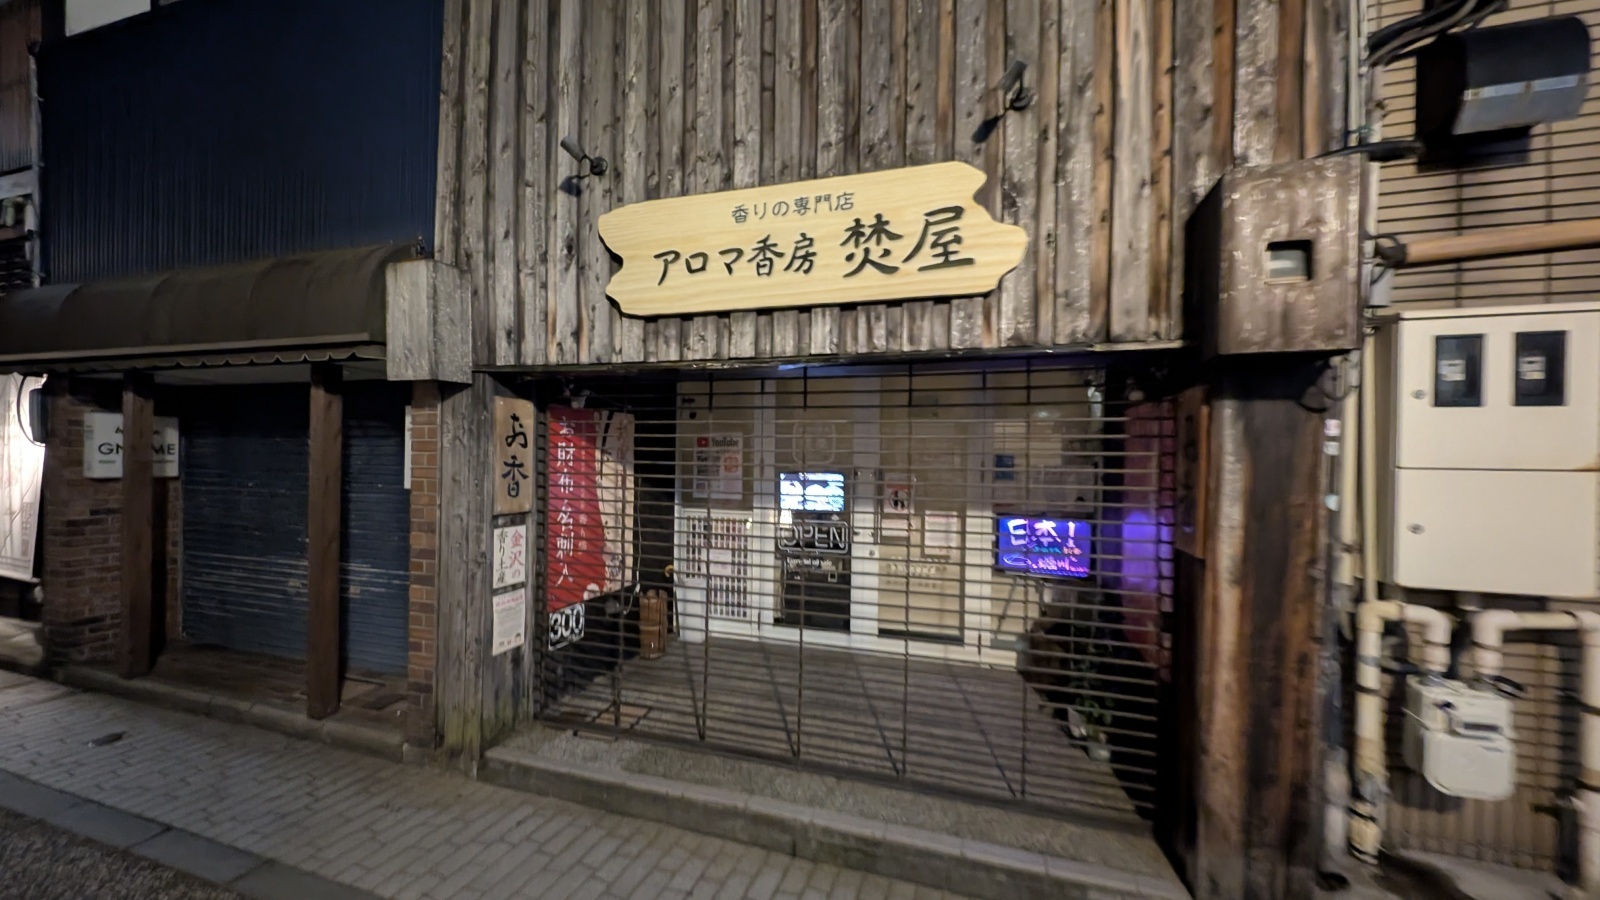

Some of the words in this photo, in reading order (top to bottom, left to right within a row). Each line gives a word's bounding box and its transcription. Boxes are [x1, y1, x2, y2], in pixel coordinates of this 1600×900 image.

[731, 191, 855, 224] 香りの専門店
[652, 232, 816, 287] アロマ香房
[838, 204, 975, 279] 焚屋
[97, 441, 176, 456] GNME
[502, 413, 528, 498] お香
[509, 529, 525, 579] 金沢の
[779, 525, 845, 549] OPEN
[550, 604, 584, 645] 300
